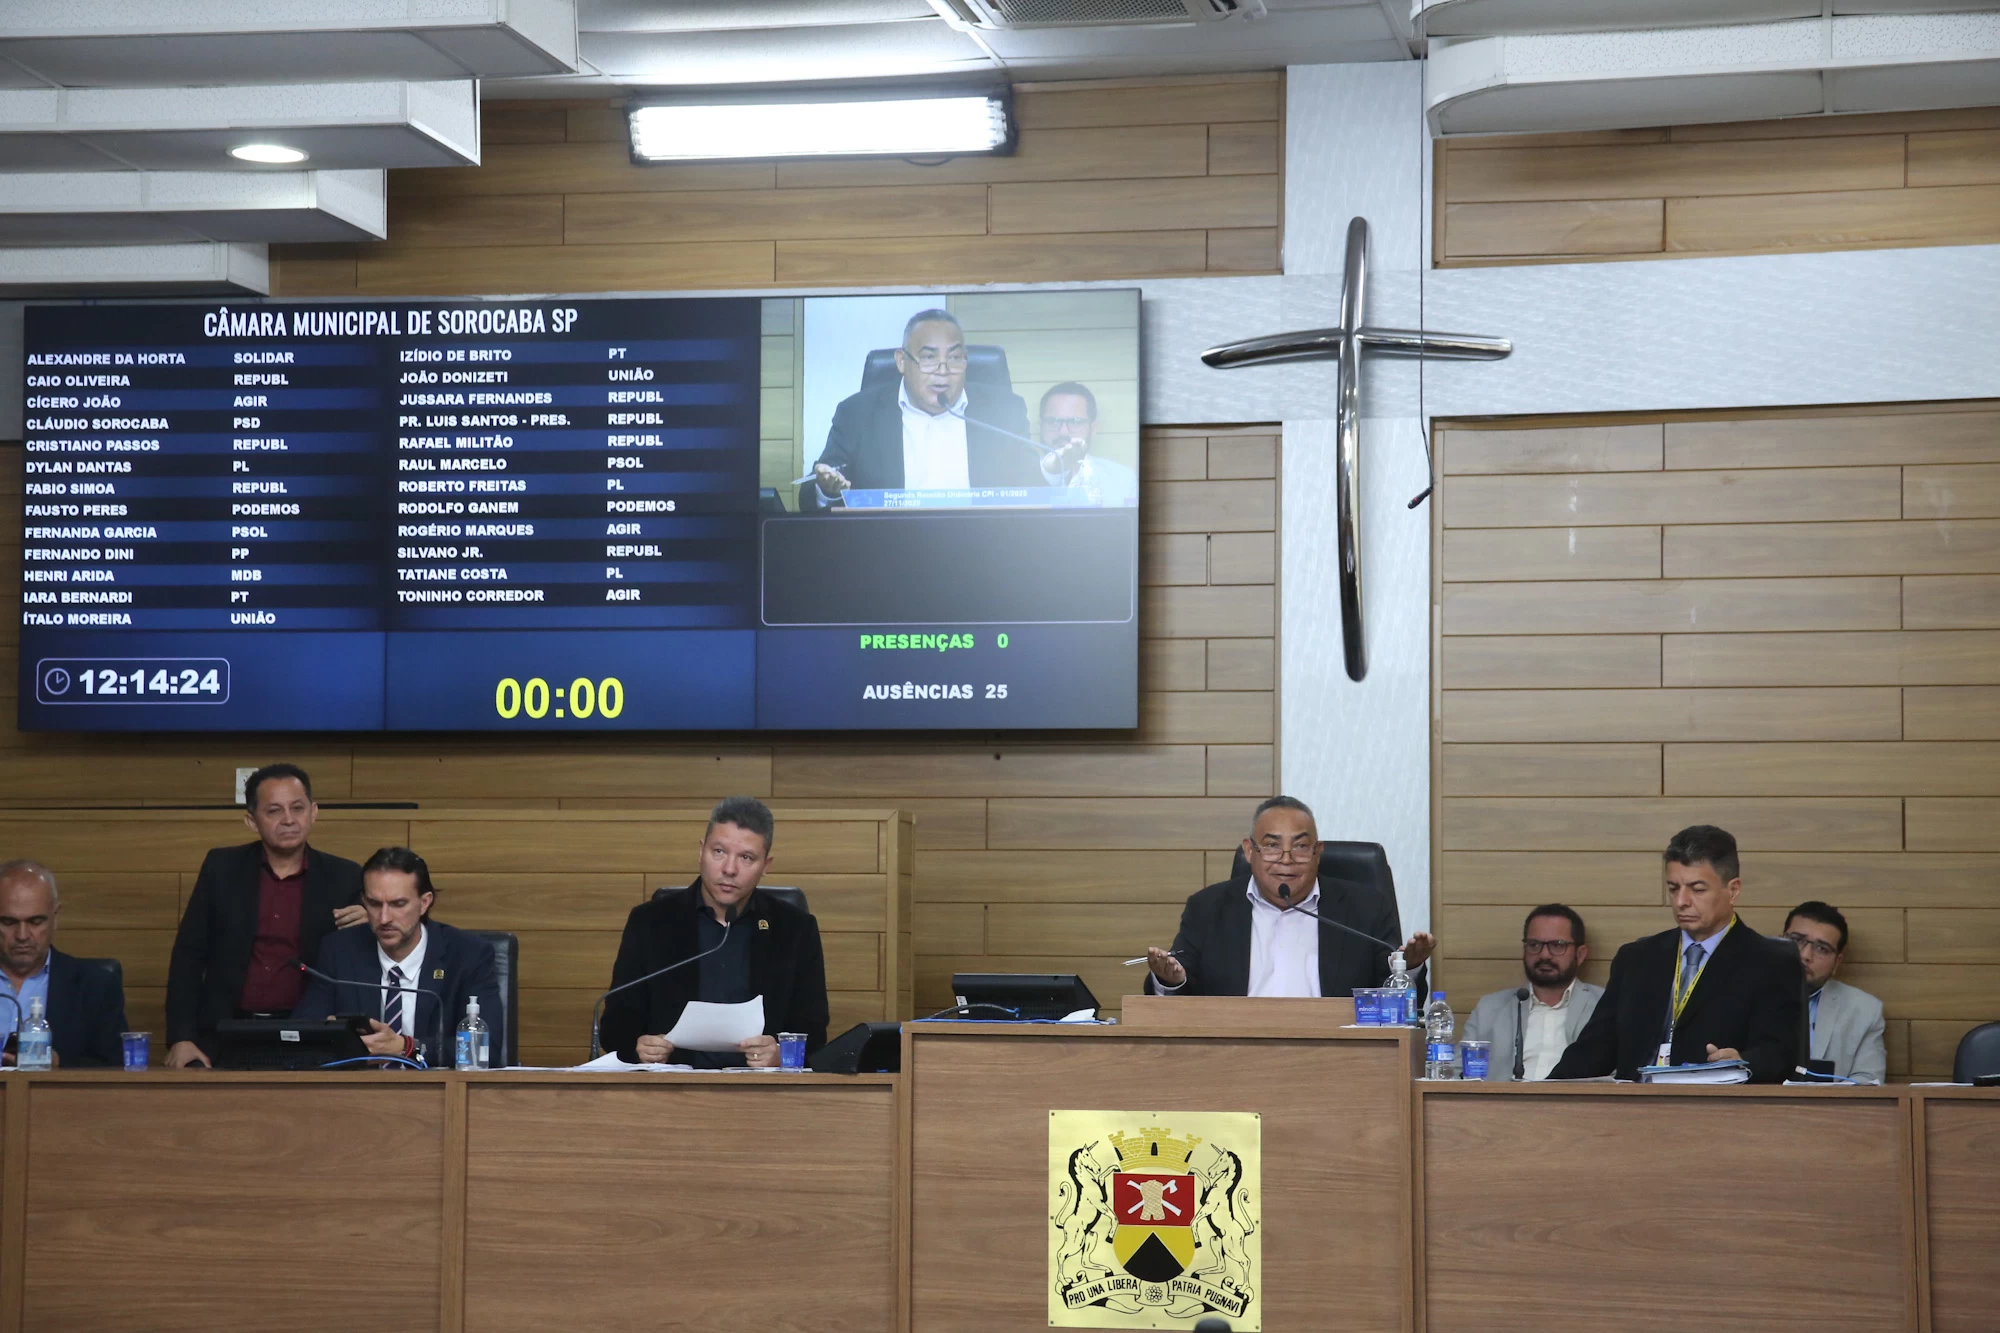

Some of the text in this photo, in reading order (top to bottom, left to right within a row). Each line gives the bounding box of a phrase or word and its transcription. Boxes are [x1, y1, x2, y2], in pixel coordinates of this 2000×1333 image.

[205, 307, 577, 337] CÂMARA MUNICIPAL DE SOROCABA SP
[28, 353, 185, 365] ALEXANDRE DA HORTA
[234, 352, 294, 363] SOLIDAR
[401, 349, 511, 362] IZÍDIO DE BRITO
[609, 348, 626, 359] PT
[234, 374, 288, 385] REPUBL
[400, 370, 507, 383] JOÃO DONIZETI
[609, 367, 654, 381] UNIÃO
[27, 376, 130, 386] CAIO OLIVEIRA
[27, 395, 121, 408] CÍCERO JOÃO
[234, 396, 267, 407] AGIR
[400, 393, 552, 405] JUSSARA FERNANDES
[609, 391, 663, 403] REPUBL
[27, 417, 169, 429] CLÁUDIO SOROCABA
[234, 418, 260, 428] PSD
[400, 416, 421, 427] PR.
[427, 416, 457, 426] LUIS
[461, 415, 518, 426] SANTOS
[531, 415, 570, 425] PRES.
[608, 413, 663, 424] REPUBL
[27, 440, 159, 451] CRISTIANO PASSOS
[234, 439, 288, 450] REPUBL
[400, 435, 513, 448] RAFAEL MILITÃO
[608, 435, 663, 446] REPUBL
[26, 462, 131, 473] DYLAN DANTAS
[233, 461, 249, 472] PL
[399, 459, 506, 470] RAUL MARCELO
[608, 457, 643, 468] PSOL
[26, 483, 115, 494] FABIO SIMOA
[233, 482, 287, 493] REPUBL
[399, 480, 526, 492] ROBERTO FREITAS
[608, 479, 624, 490] PL
[26, 505, 127, 516] FAUSTO PERES
[233, 504, 300, 515] PODEMOS
[399, 502, 518, 513] RODOLFO GANEM
[607, 501, 675, 512] PODEMOS
[25, 527, 157, 538] FERNANDA GARCIA
[232, 527, 267, 537] PSOL
[399, 523, 534, 536] ROGÉRIO MARQUES
[607, 524, 641, 534] AGIR
[25, 549, 133, 560] FERNANDO DINI
[232, 548, 249, 559] PP
[398, 547, 483, 558] SILVANO JR.
[607, 545, 662, 556] REPUBL
[25, 571, 114, 581] HENRI ARIDA
[232, 570, 262, 581] MDB
[398, 569, 507, 580] TATIANE COSTA
[607, 568, 623, 578] PL
[24, 592, 132, 603] IARA BERNARDI
[231, 592, 249, 602] PT
[397, 590, 544, 602] TONINHO CORREDOR
[606, 589, 640, 600] AGIR
[24, 612, 131, 624] ÍTALO MOREIRA
[231, 611, 275, 624] UNIÃO
[861, 634, 1008, 652] PRESENÇAS 0
[80, 669, 220, 694] 12:14:24
[863, 681, 1007, 699] AUSÊNCIAS 25
[496, 678, 623, 718] 00:00
[1068, 1278, 1240, 1313] PRO UNA LIBERA PATRIA PUGNAVI
